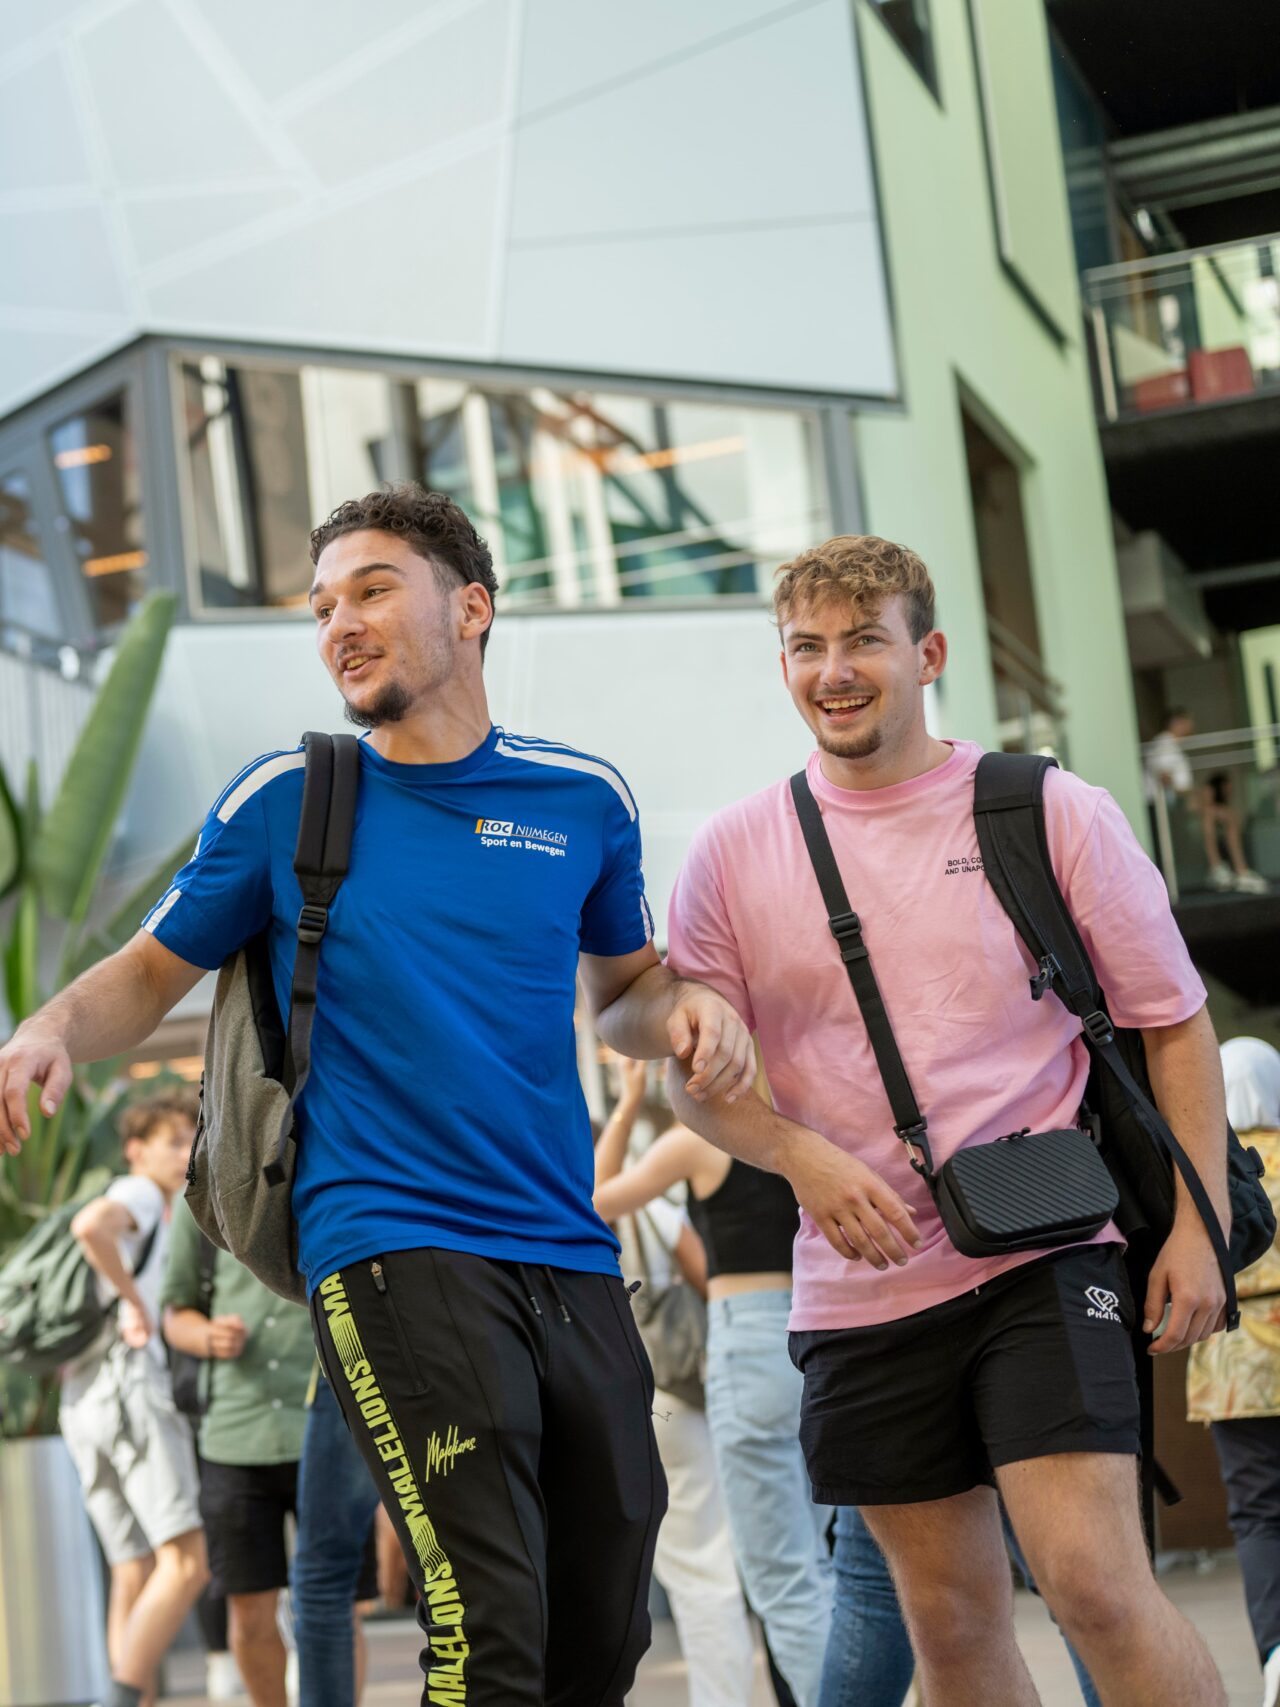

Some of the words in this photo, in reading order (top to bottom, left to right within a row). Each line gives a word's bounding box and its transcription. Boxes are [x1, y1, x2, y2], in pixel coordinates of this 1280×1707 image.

[481, 821, 511, 834] ROC
[515, 825, 568, 844] NIJMEGEN
[480, 837, 508, 848] Sport
[510, 840, 522, 848] en
[525, 841, 566, 857] Bewegen
[944, 867, 960, 876] AND
[961, 865, 986, 873] UNAPO
[947, 857, 970, 867] BOLD,
[970, 856, 983, 864] CO
[343, 1358, 433, 1540] MALELIONS
